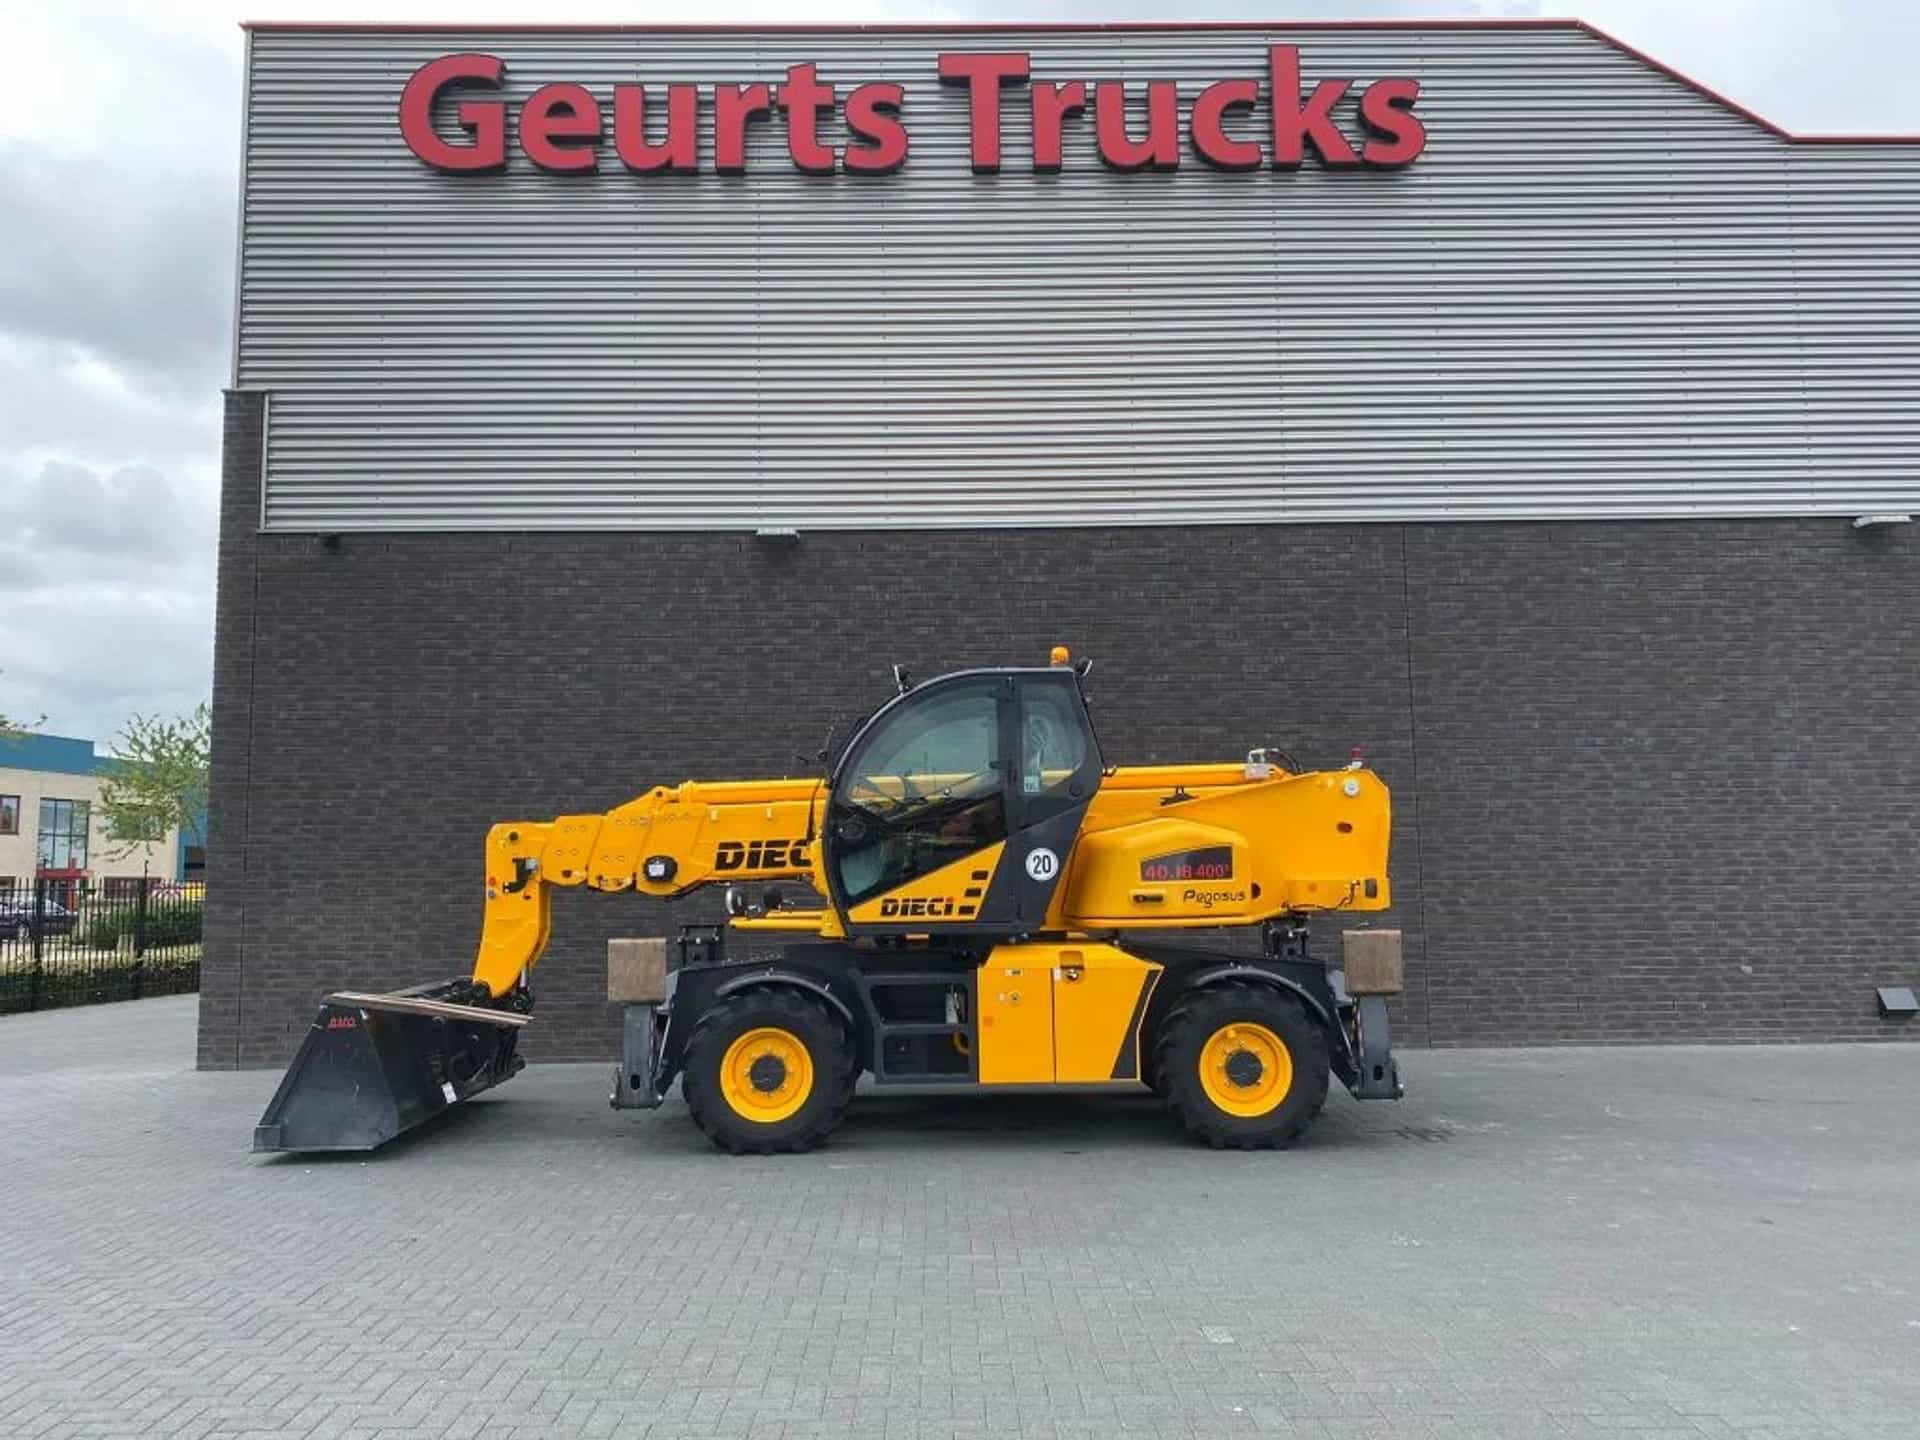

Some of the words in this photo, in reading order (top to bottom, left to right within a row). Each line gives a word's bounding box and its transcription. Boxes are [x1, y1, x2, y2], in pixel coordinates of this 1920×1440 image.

[400, 52, 910, 176] Geurts
[937, 45, 1428, 174] Trucks
[715, 838, 812, 871] DIEC
[1032, 855, 1052, 874] 20
[881, 897, 955, 917] DIECI
[1183, 889, 1246, 908] Pegasus
